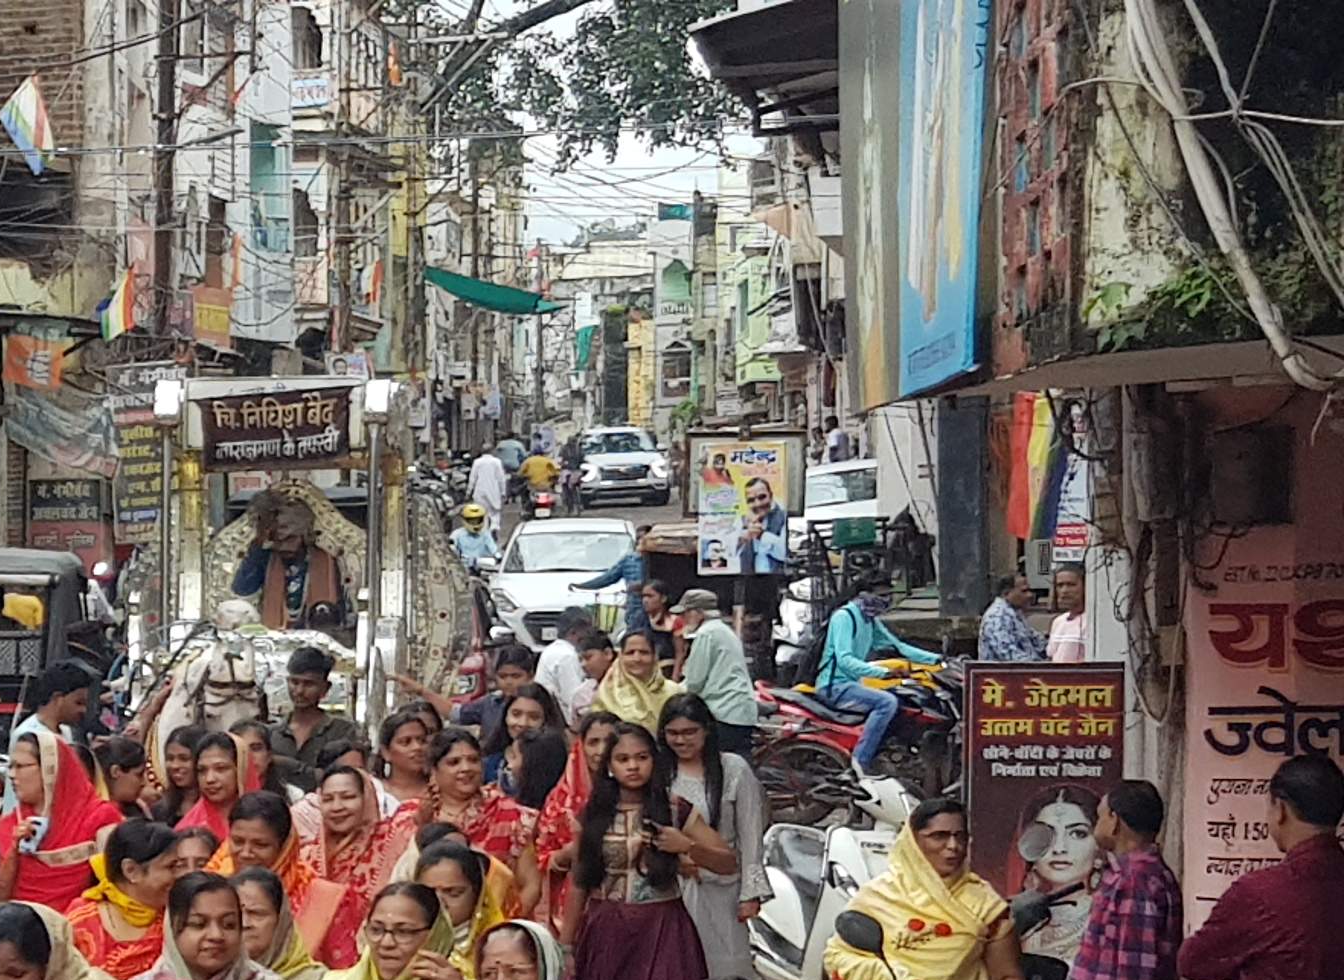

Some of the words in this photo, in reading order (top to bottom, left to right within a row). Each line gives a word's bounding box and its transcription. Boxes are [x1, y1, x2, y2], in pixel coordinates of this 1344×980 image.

[981, 678, 1014, 708] मे.
[1023, 677, 1115, 708] जेठमल
[978, 717, 1034, 737] उत्तम
[1076, 712, 1116, 737] जैन
